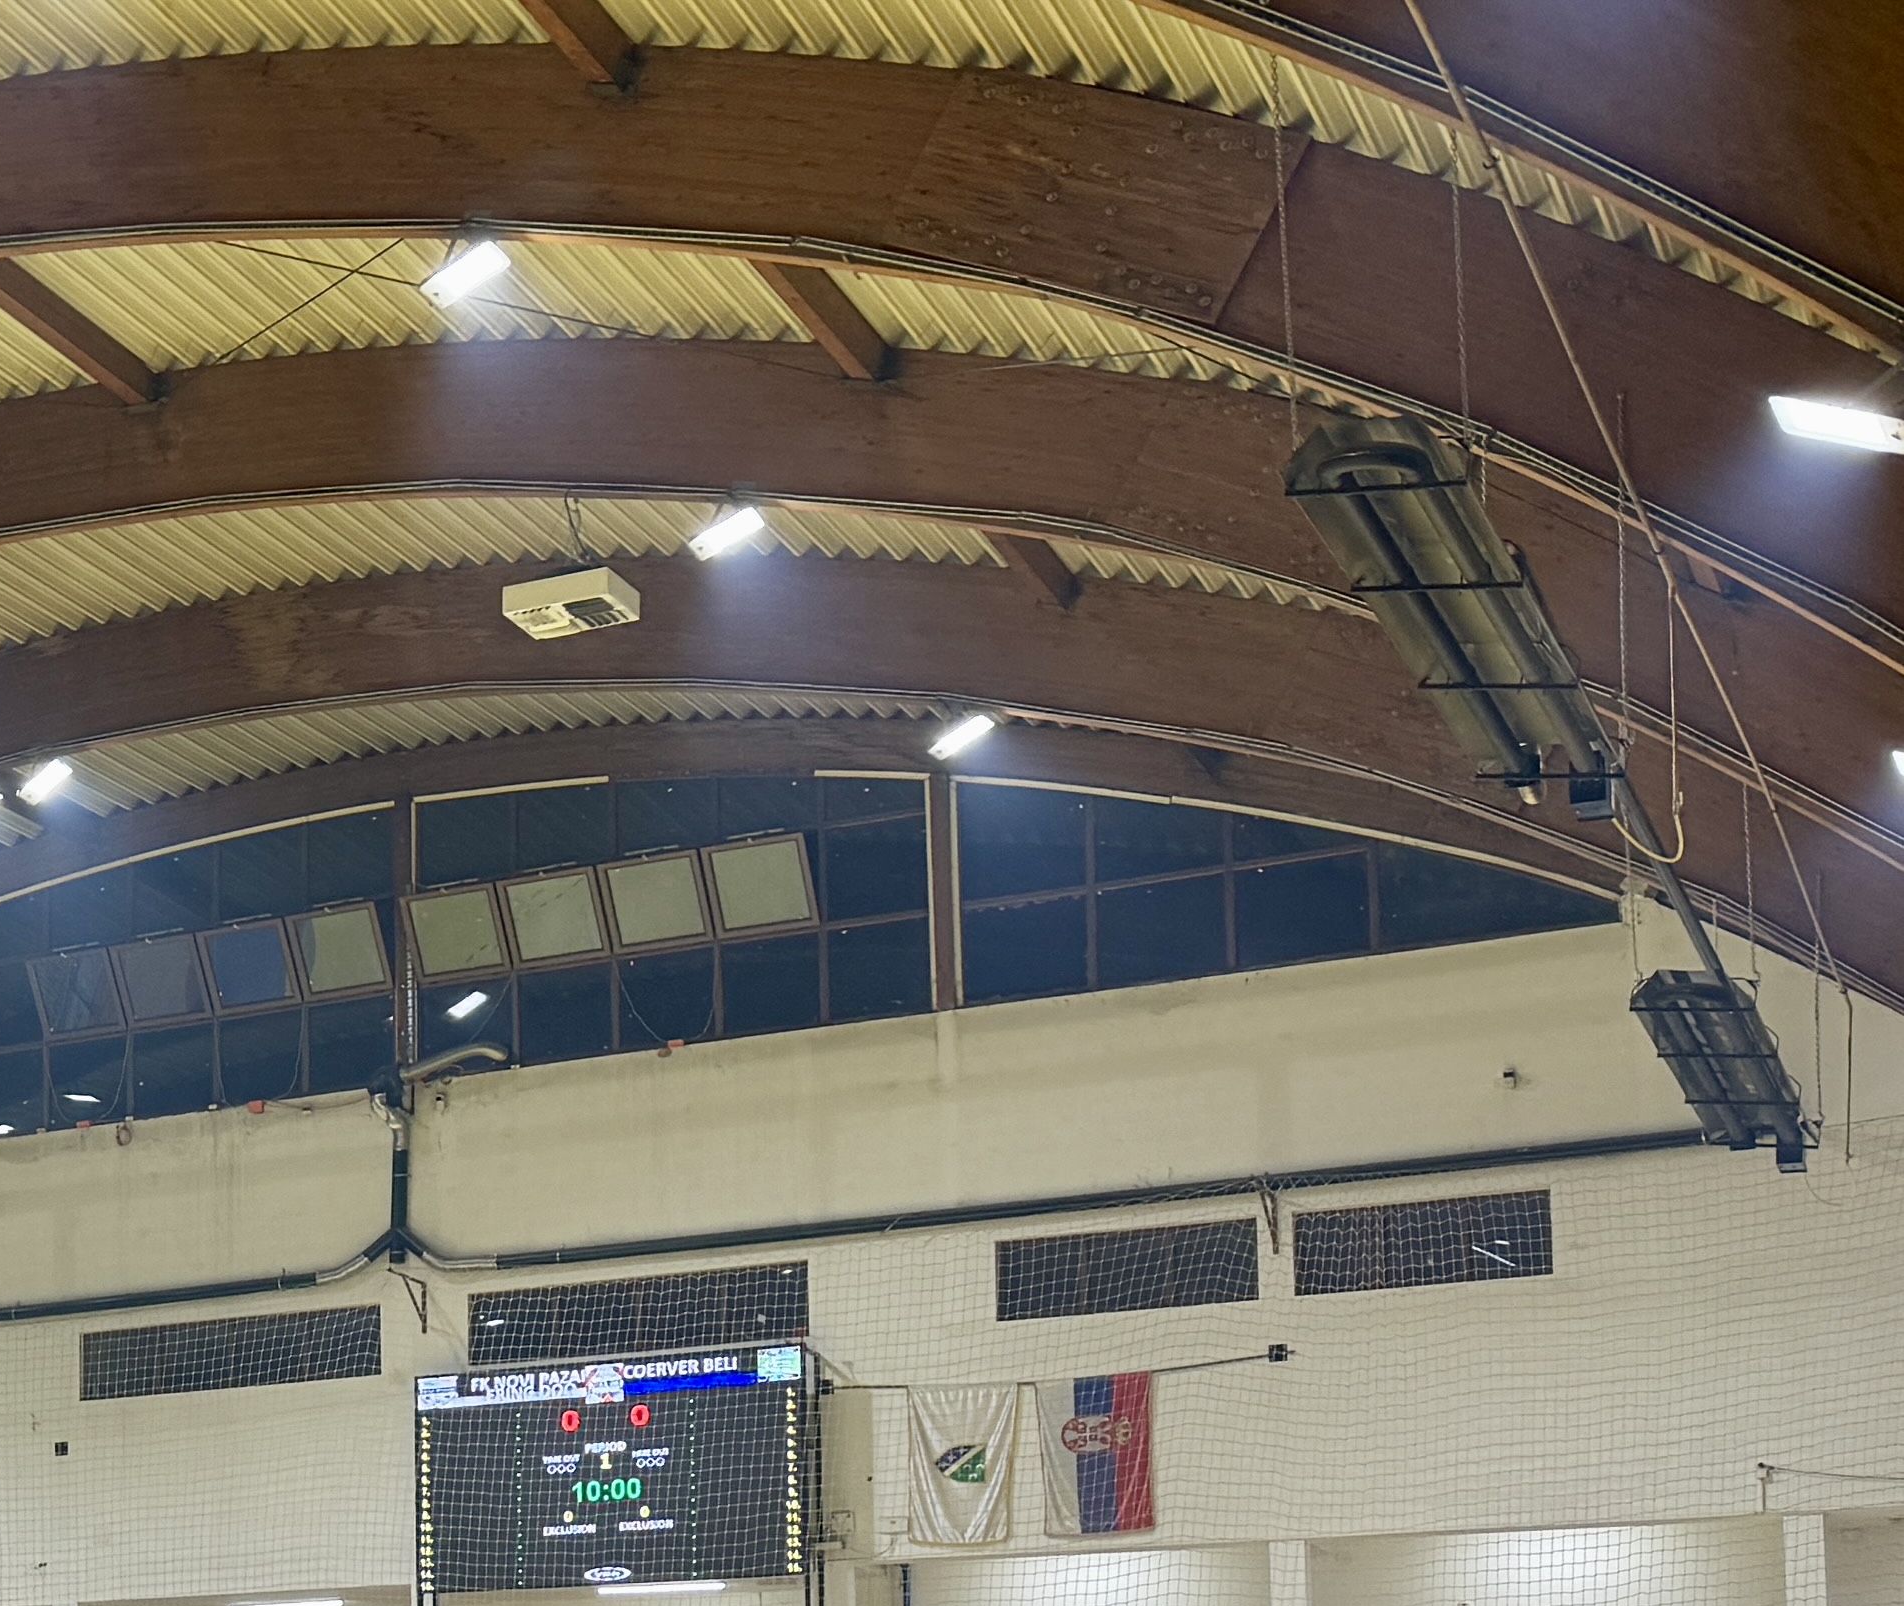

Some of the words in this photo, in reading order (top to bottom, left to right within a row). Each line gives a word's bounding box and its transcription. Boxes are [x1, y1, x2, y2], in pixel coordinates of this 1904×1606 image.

[471, 1377, 491, 1392] FK
[561, 1409, 582, 1433] 0
[629, 1403, 651, 1428] 0
[572, 1477, 641, 1503] 10:00
